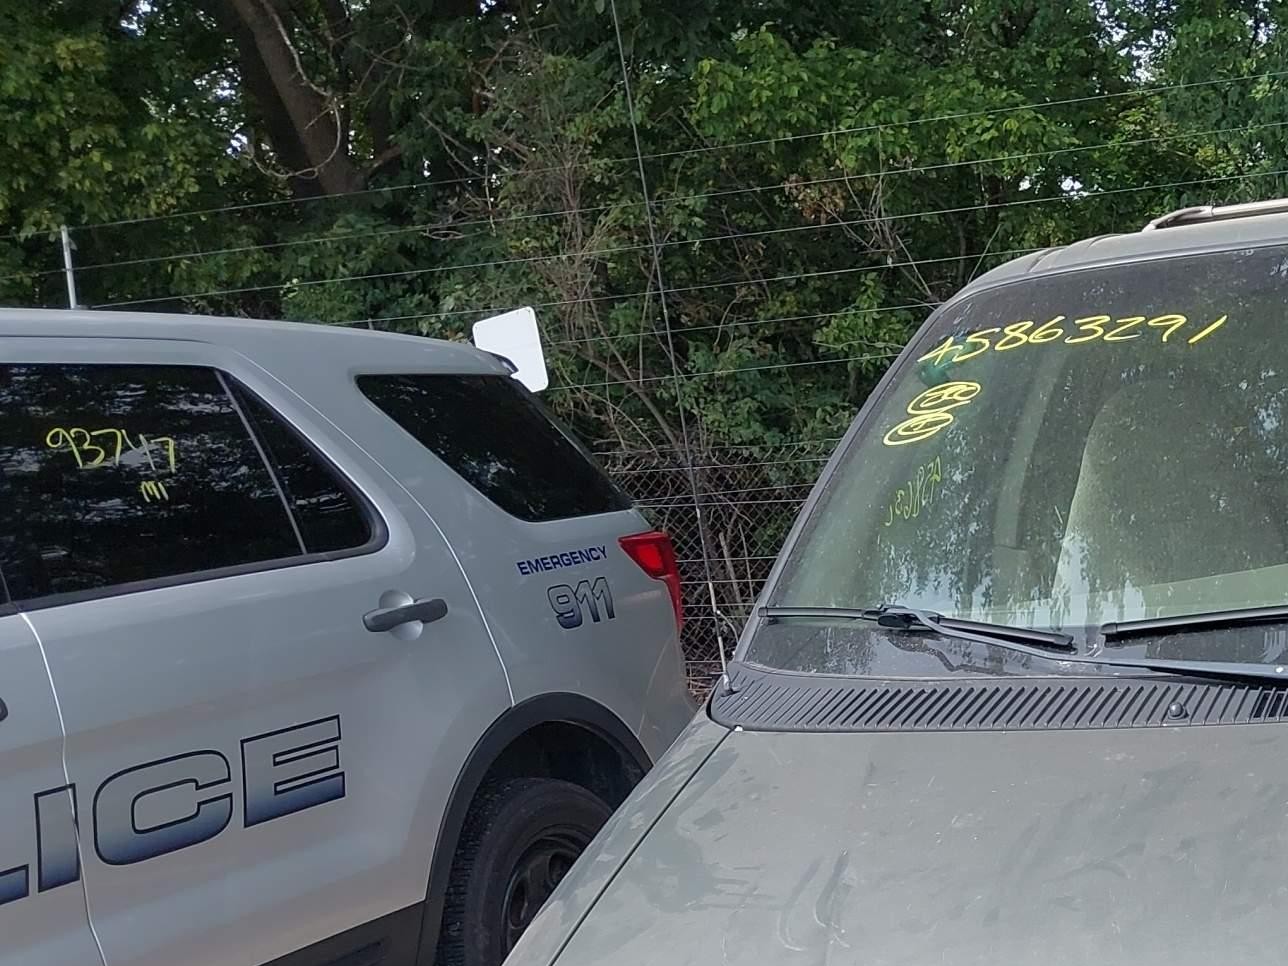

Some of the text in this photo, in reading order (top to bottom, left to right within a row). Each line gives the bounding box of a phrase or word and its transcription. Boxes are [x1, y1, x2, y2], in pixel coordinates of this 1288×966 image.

[917, 314, 1228, 365] 45863291
[516, 545, 608, 576] EMERGENCY
[547, 576, 616, 630] 911
